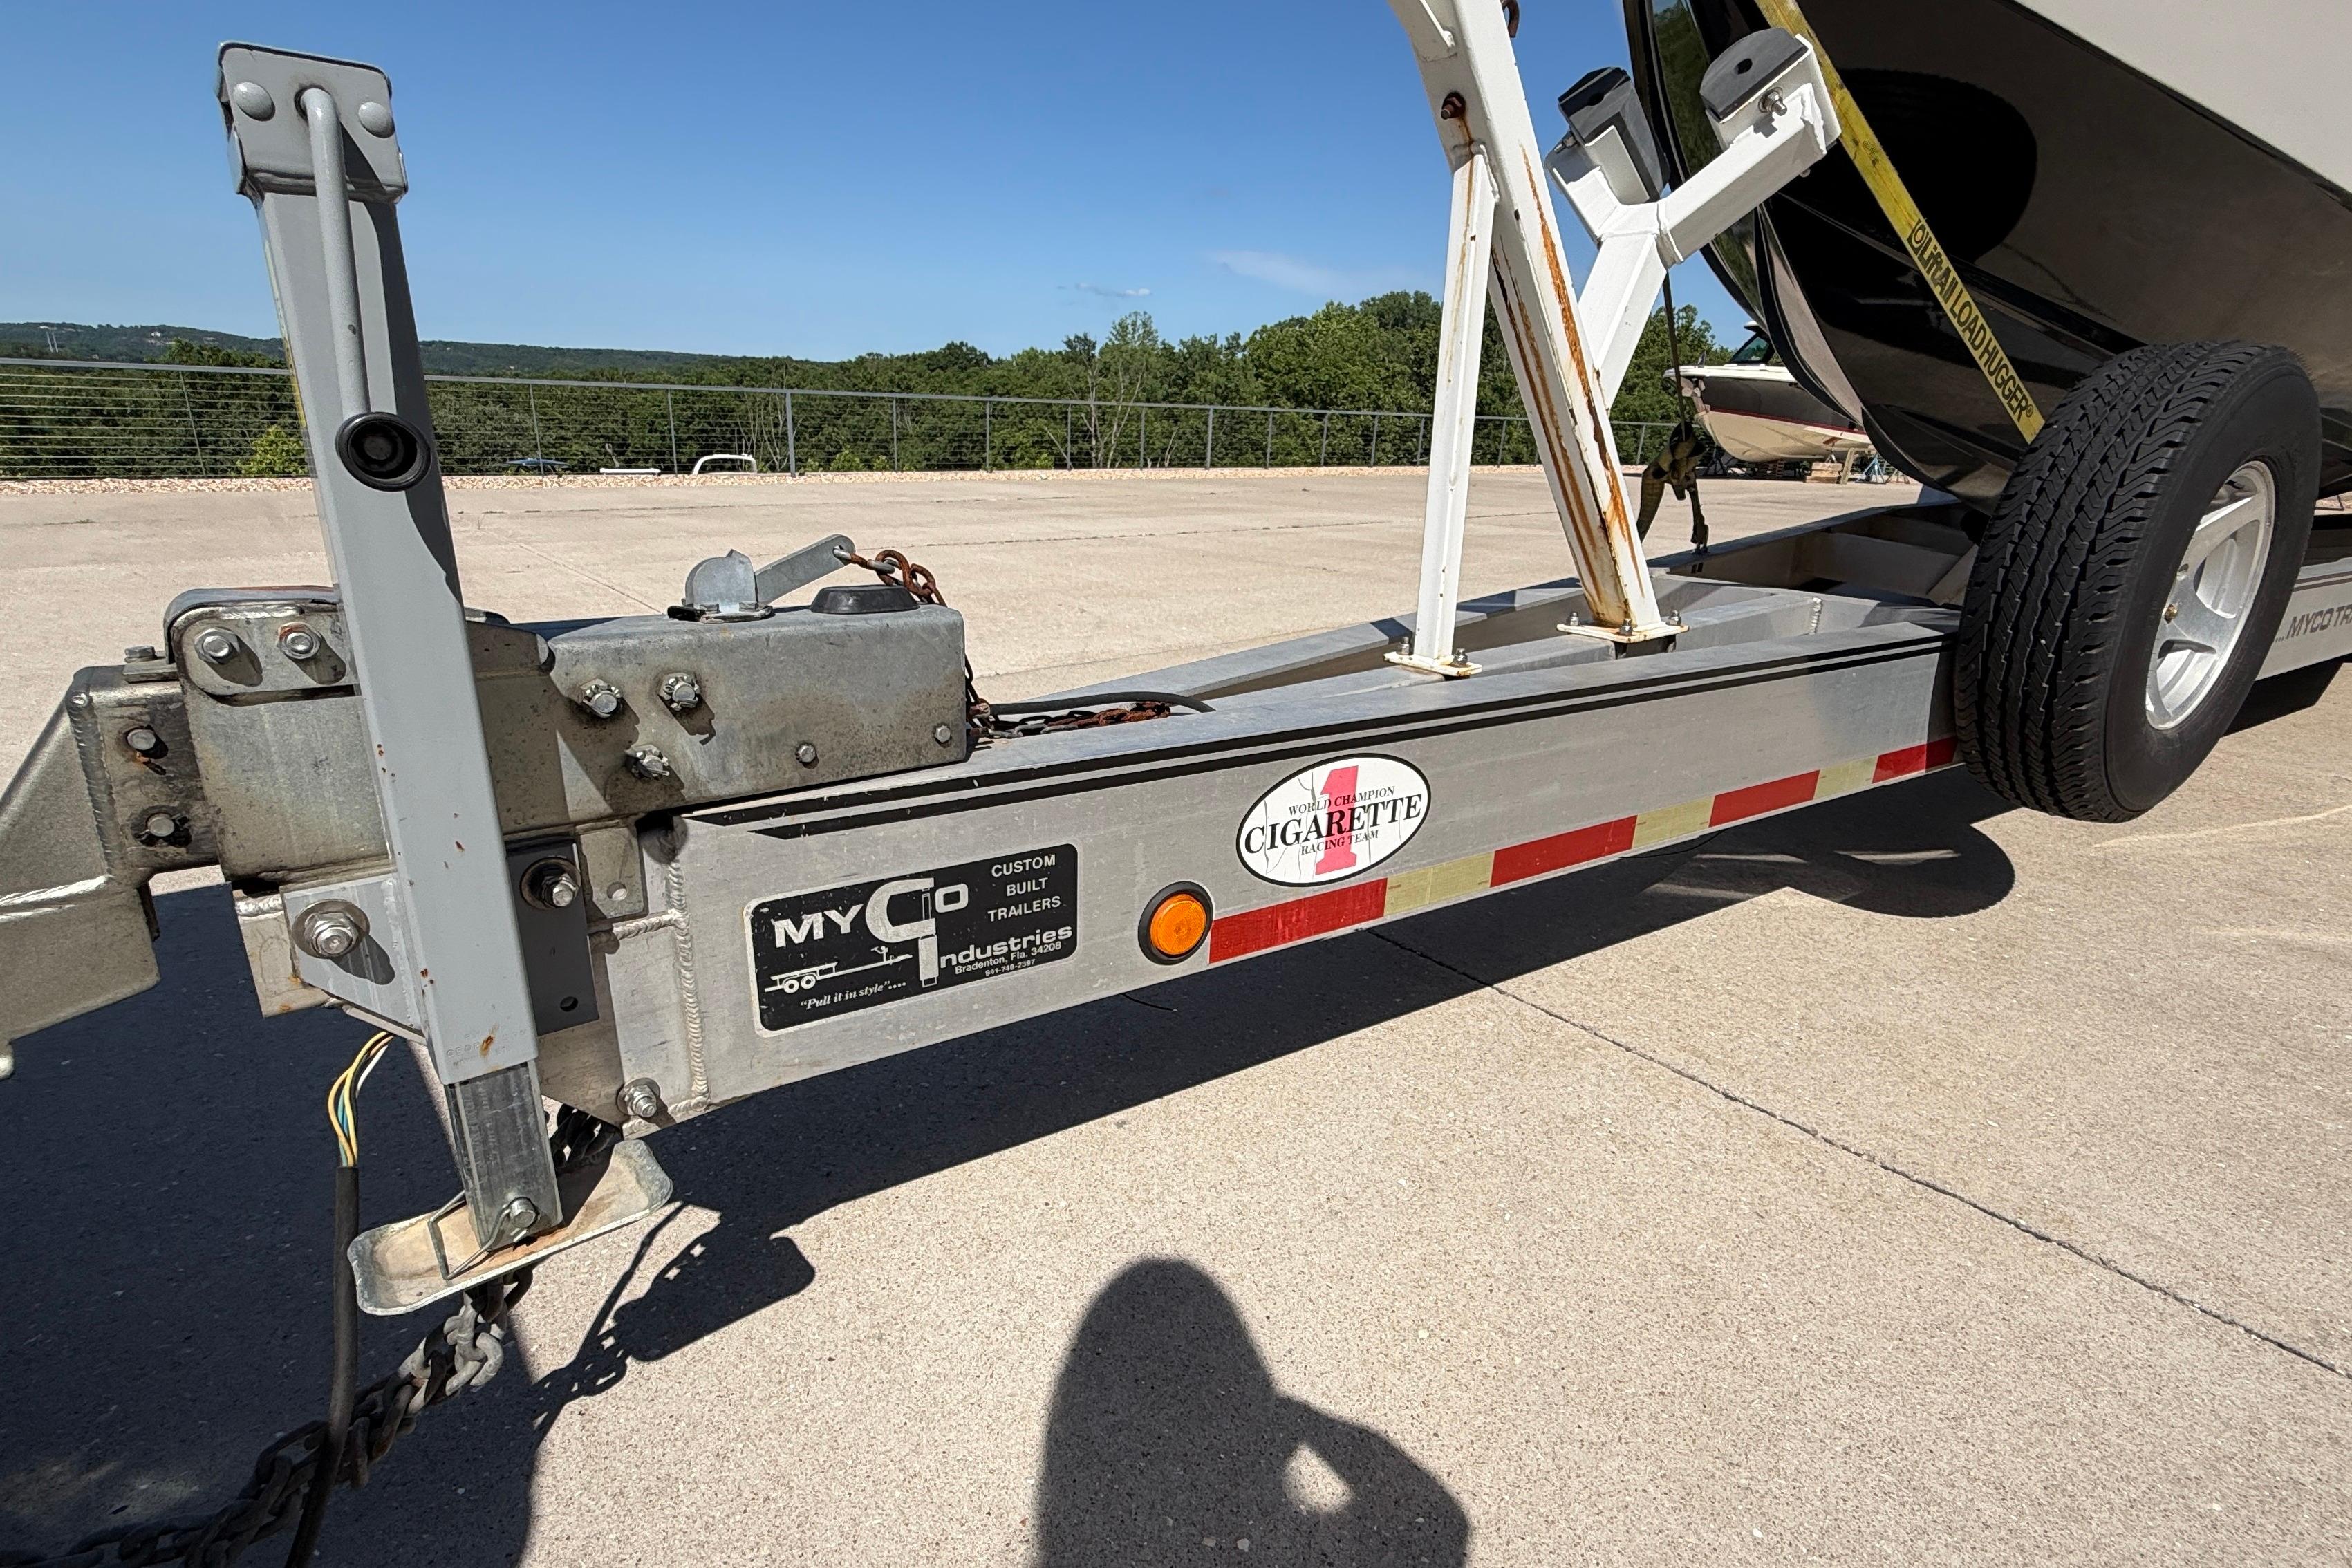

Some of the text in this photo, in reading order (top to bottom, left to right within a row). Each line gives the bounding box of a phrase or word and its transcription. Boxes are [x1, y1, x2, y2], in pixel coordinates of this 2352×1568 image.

[1289, 786, 1395, 816] WORLD CHAMPION
[1244, 794, 1422, 854] CIGARETTE
[1300, 830, 1379, 855] RACING TEAM
[991, 854, 1056, 878] CUSTOM
[1007, 877, 1049, 897] BUILT
[988, 895, 1061, 923] TRAILERS
[955, 941, 1062, 975] Bradenton, Fla. 34208
[834, 991, 843, 1003] it
[844, 990, 857, 1000] in
